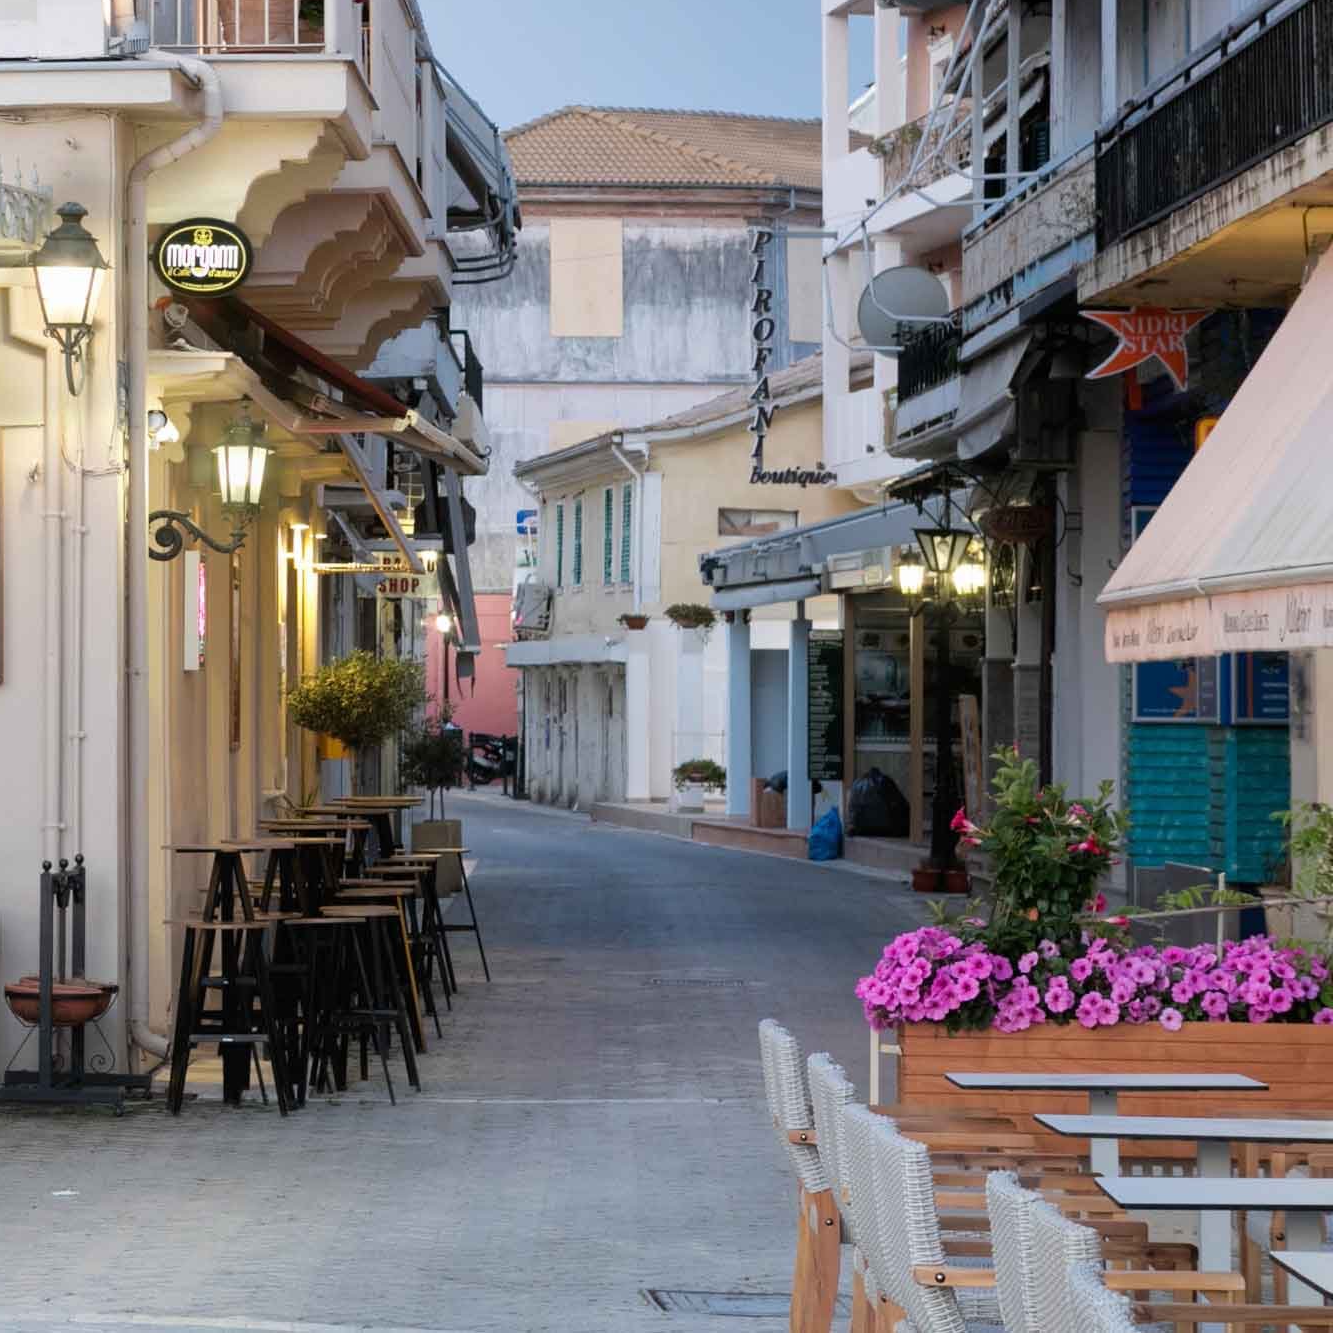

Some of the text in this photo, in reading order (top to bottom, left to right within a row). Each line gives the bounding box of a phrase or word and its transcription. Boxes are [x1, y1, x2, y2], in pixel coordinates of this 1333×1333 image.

[1120, 314, 1187, 334] NIDRI
[750, 230, 780, 457] PIROFANI
[1124, 335, 1185, 353] STAR
[749, 465, 836, 488] boutique
[379, 577, 420, 593] SHOP
